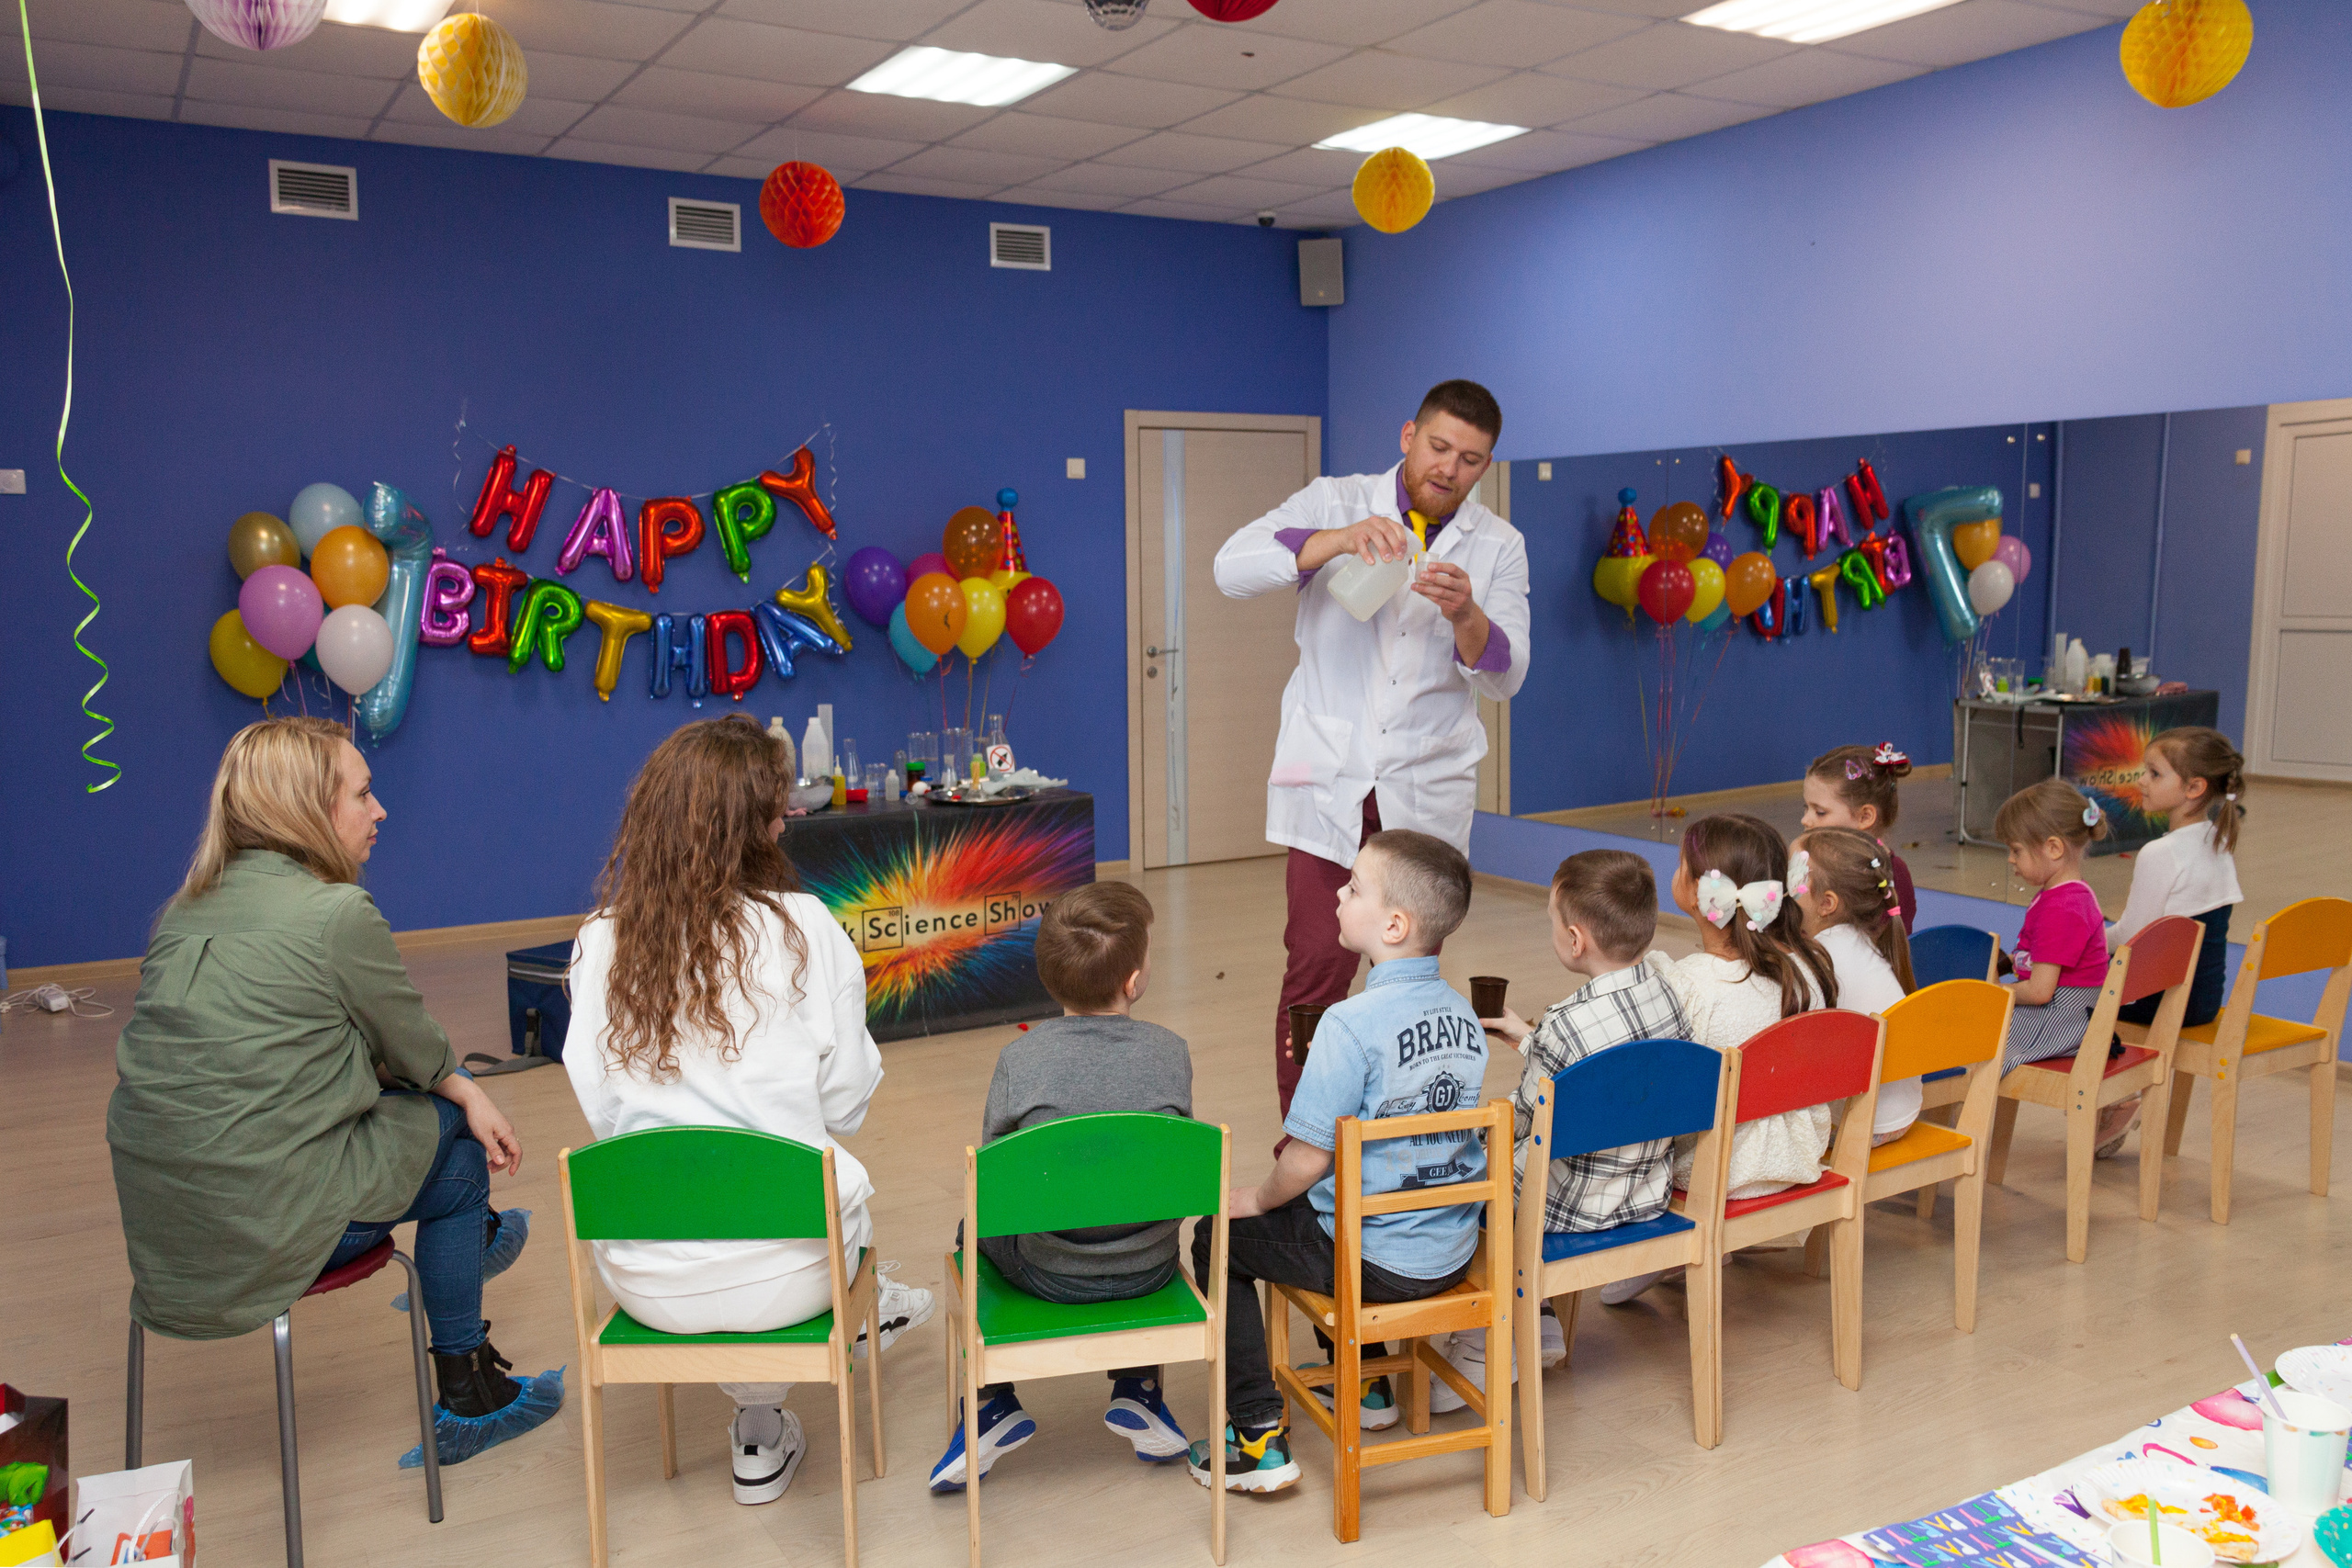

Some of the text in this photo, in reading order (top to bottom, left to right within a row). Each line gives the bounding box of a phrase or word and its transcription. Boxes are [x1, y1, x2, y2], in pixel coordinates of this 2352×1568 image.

[469, 445, 838, 592] HAPPY
[419, 548, 853, 707] BIRTHDAY
[868, 912, 978, 940] Science
[1396, 1015, 1483, 1067] BRAVE
[1435, 1085, 1453, 1108] GJ
